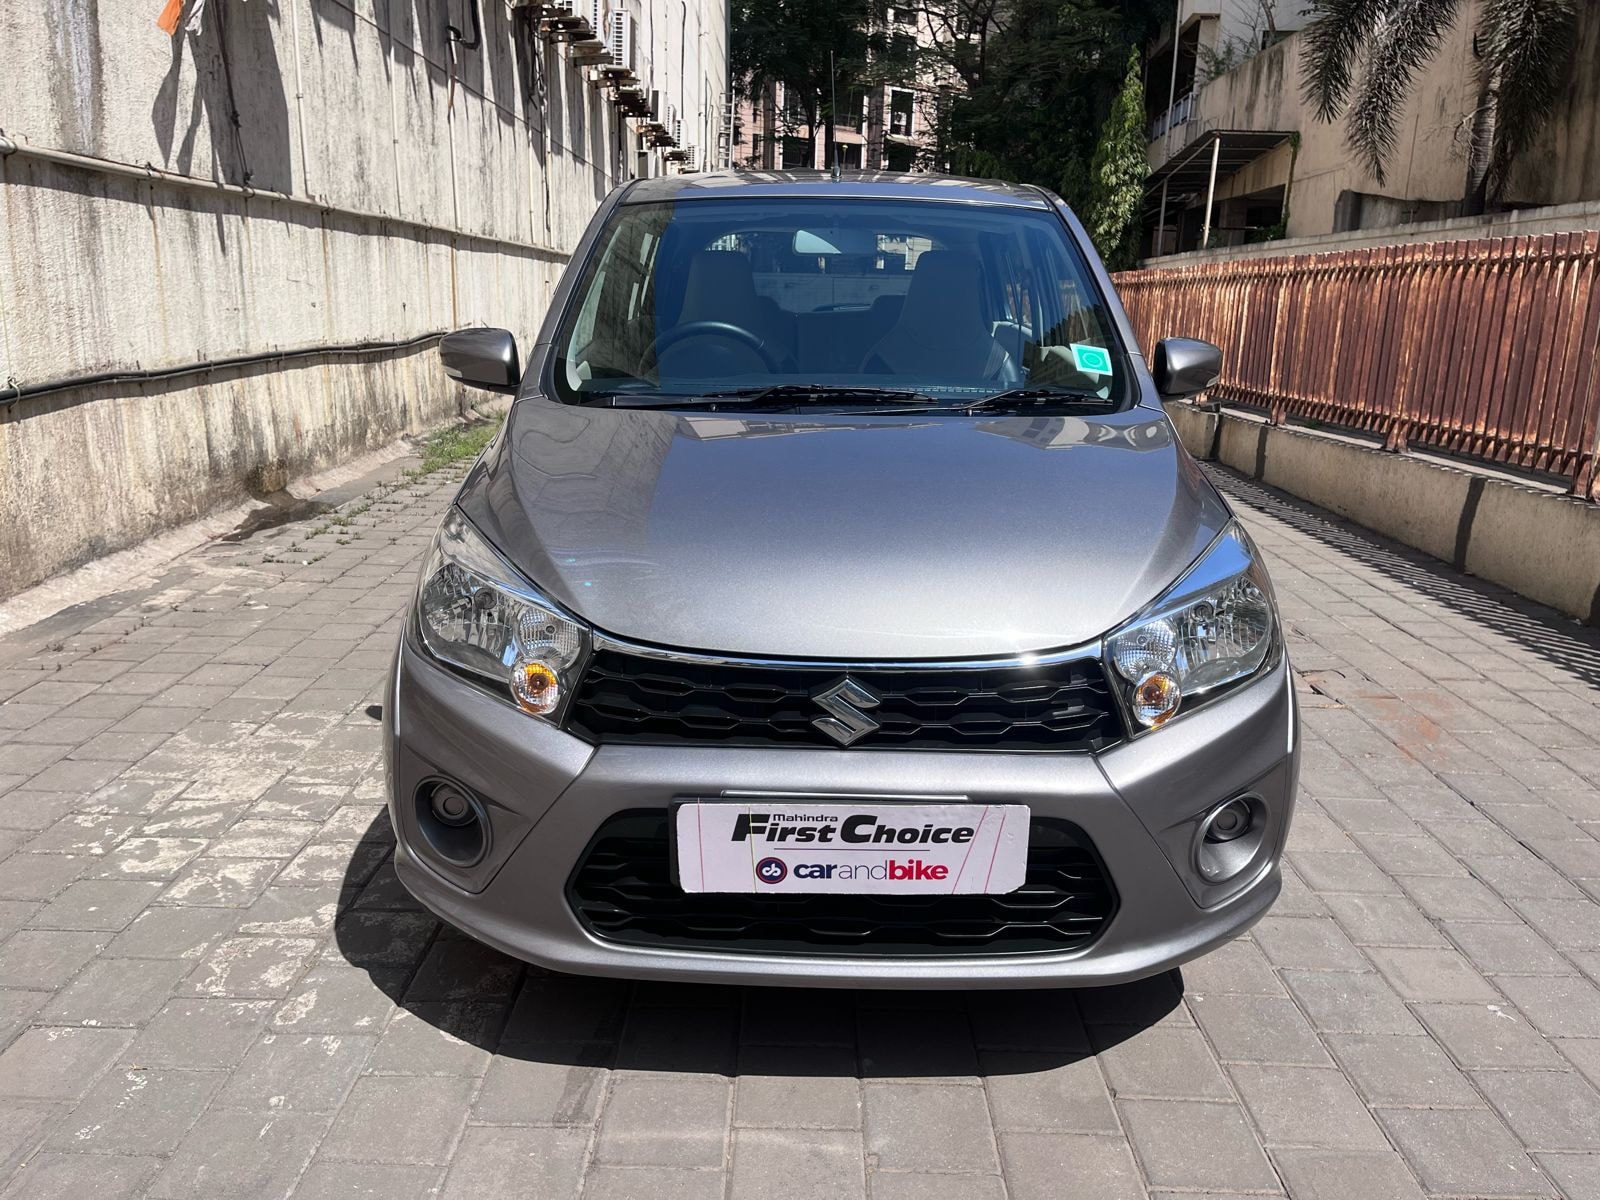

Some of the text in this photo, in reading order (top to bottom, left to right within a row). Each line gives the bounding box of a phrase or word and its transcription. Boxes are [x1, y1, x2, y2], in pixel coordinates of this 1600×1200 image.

[731, 813, 975, 844] First Choice
[773, 813, 838, 823] Mahindra
[793, 859, 949, 881] carandbike
